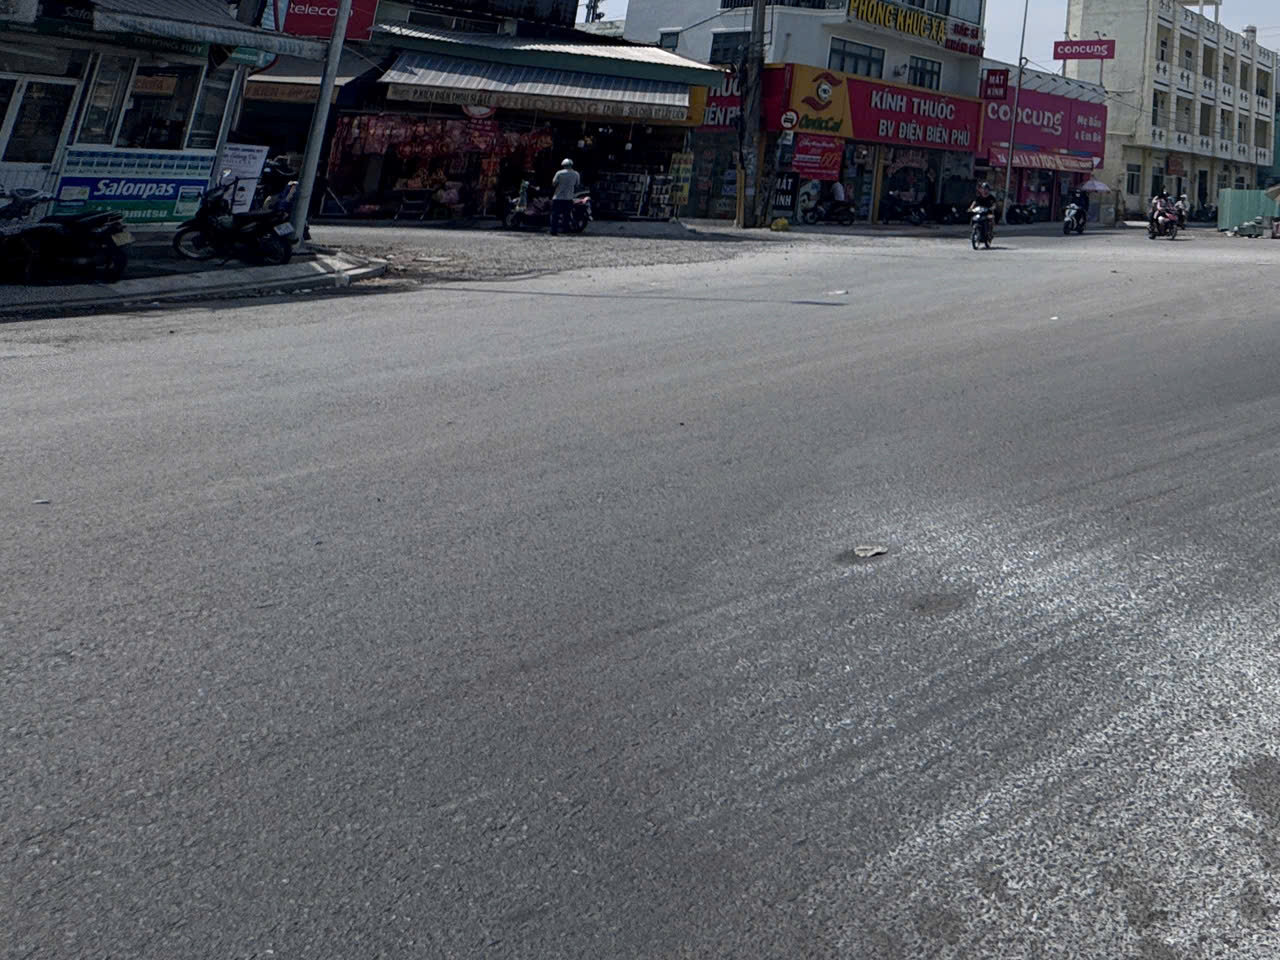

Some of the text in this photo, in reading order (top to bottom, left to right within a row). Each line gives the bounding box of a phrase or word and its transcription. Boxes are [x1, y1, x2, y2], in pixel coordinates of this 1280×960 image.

[290, 1, 354, 17] teleco
[929, 17, 948, 46] XẠ
[871, 88, 956, 121] KÍNH THUỐC
[879, 119, 971, 146] BV ĐIỆN BIÊN PHỦ
[93, 178, 176, 198] Salonpas
